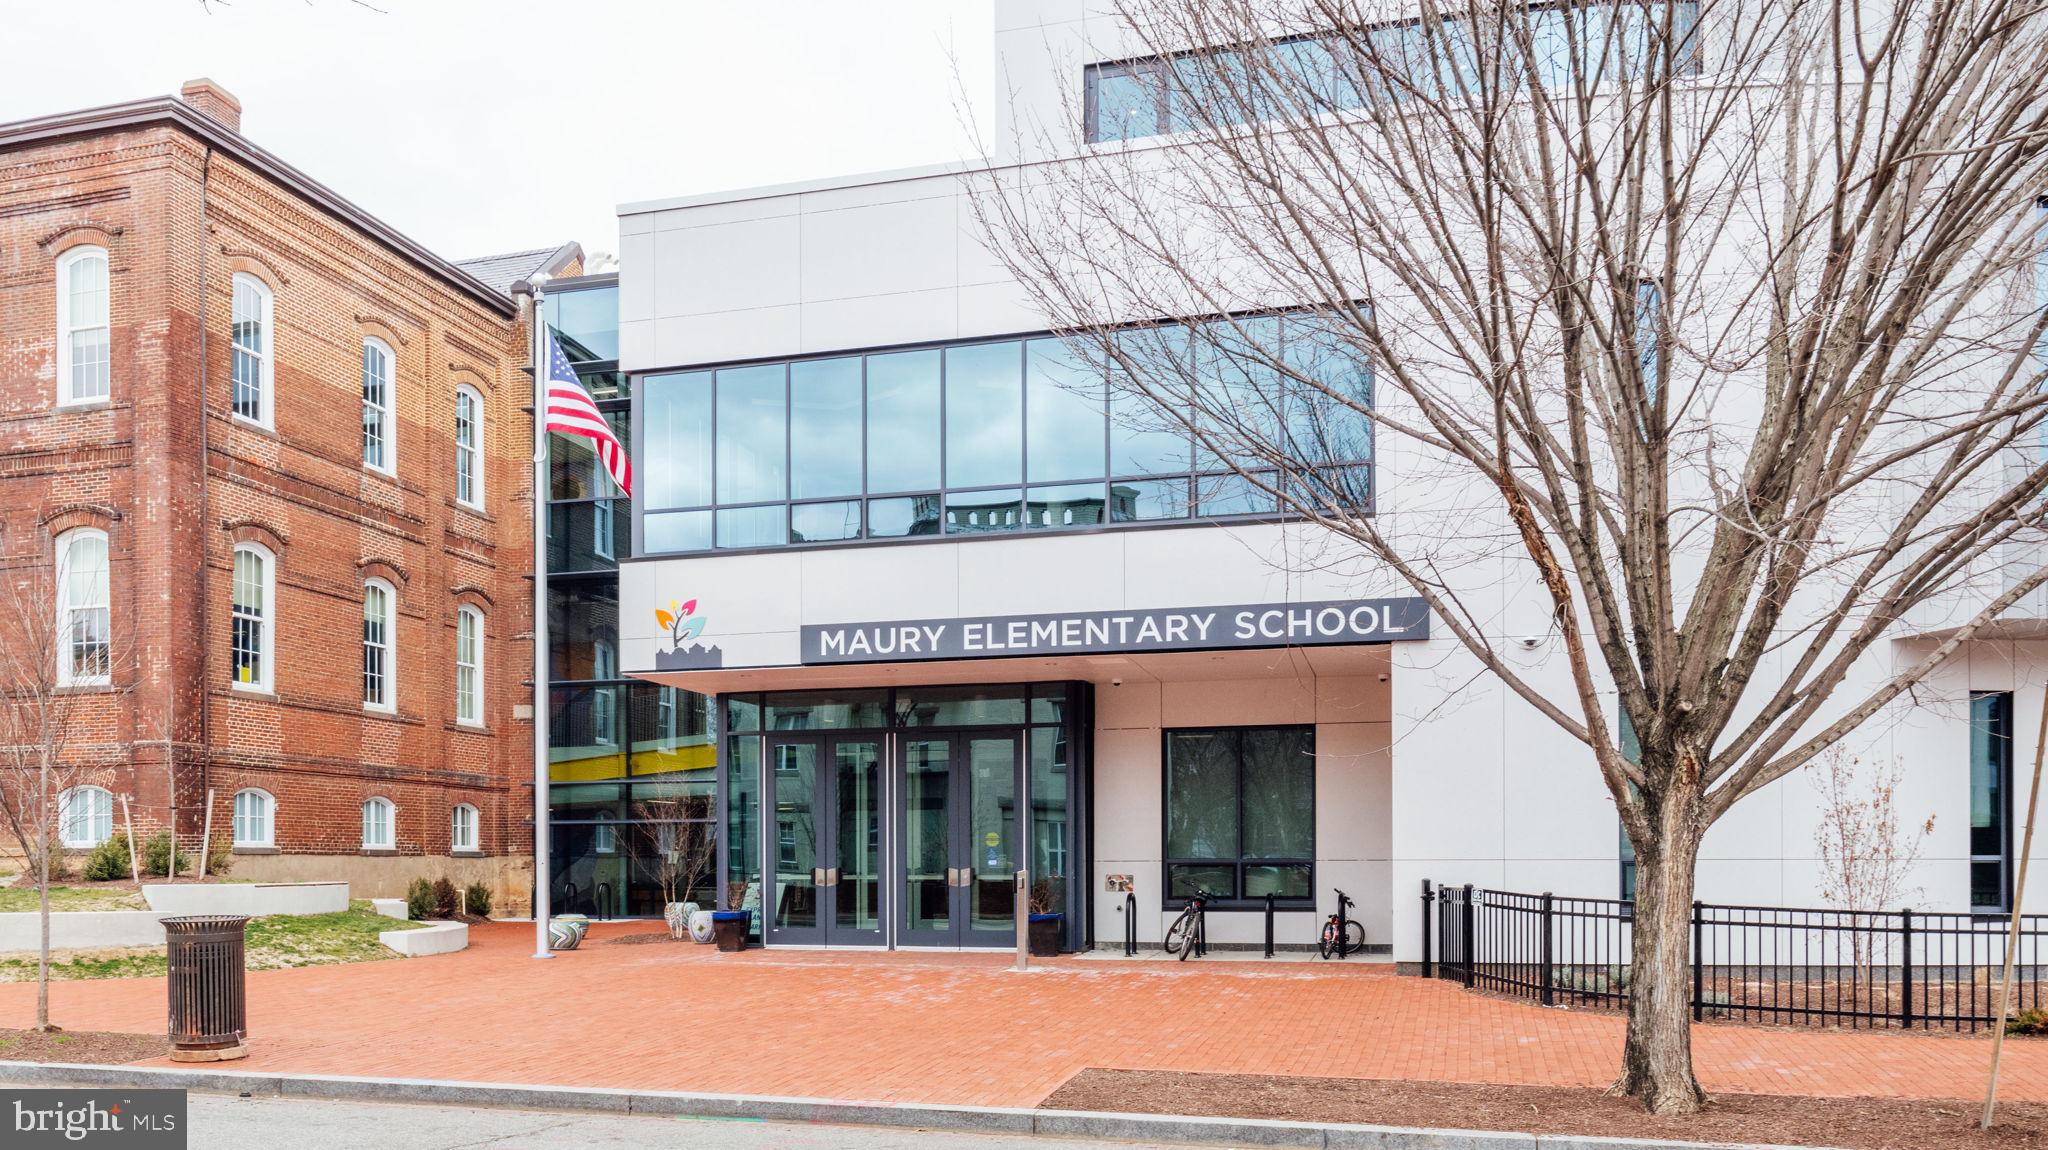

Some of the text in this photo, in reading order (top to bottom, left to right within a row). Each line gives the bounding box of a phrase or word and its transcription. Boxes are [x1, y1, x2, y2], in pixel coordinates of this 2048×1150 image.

[820, 606, 1404, 656] MAURY ELEMENTARY SCHOOL
